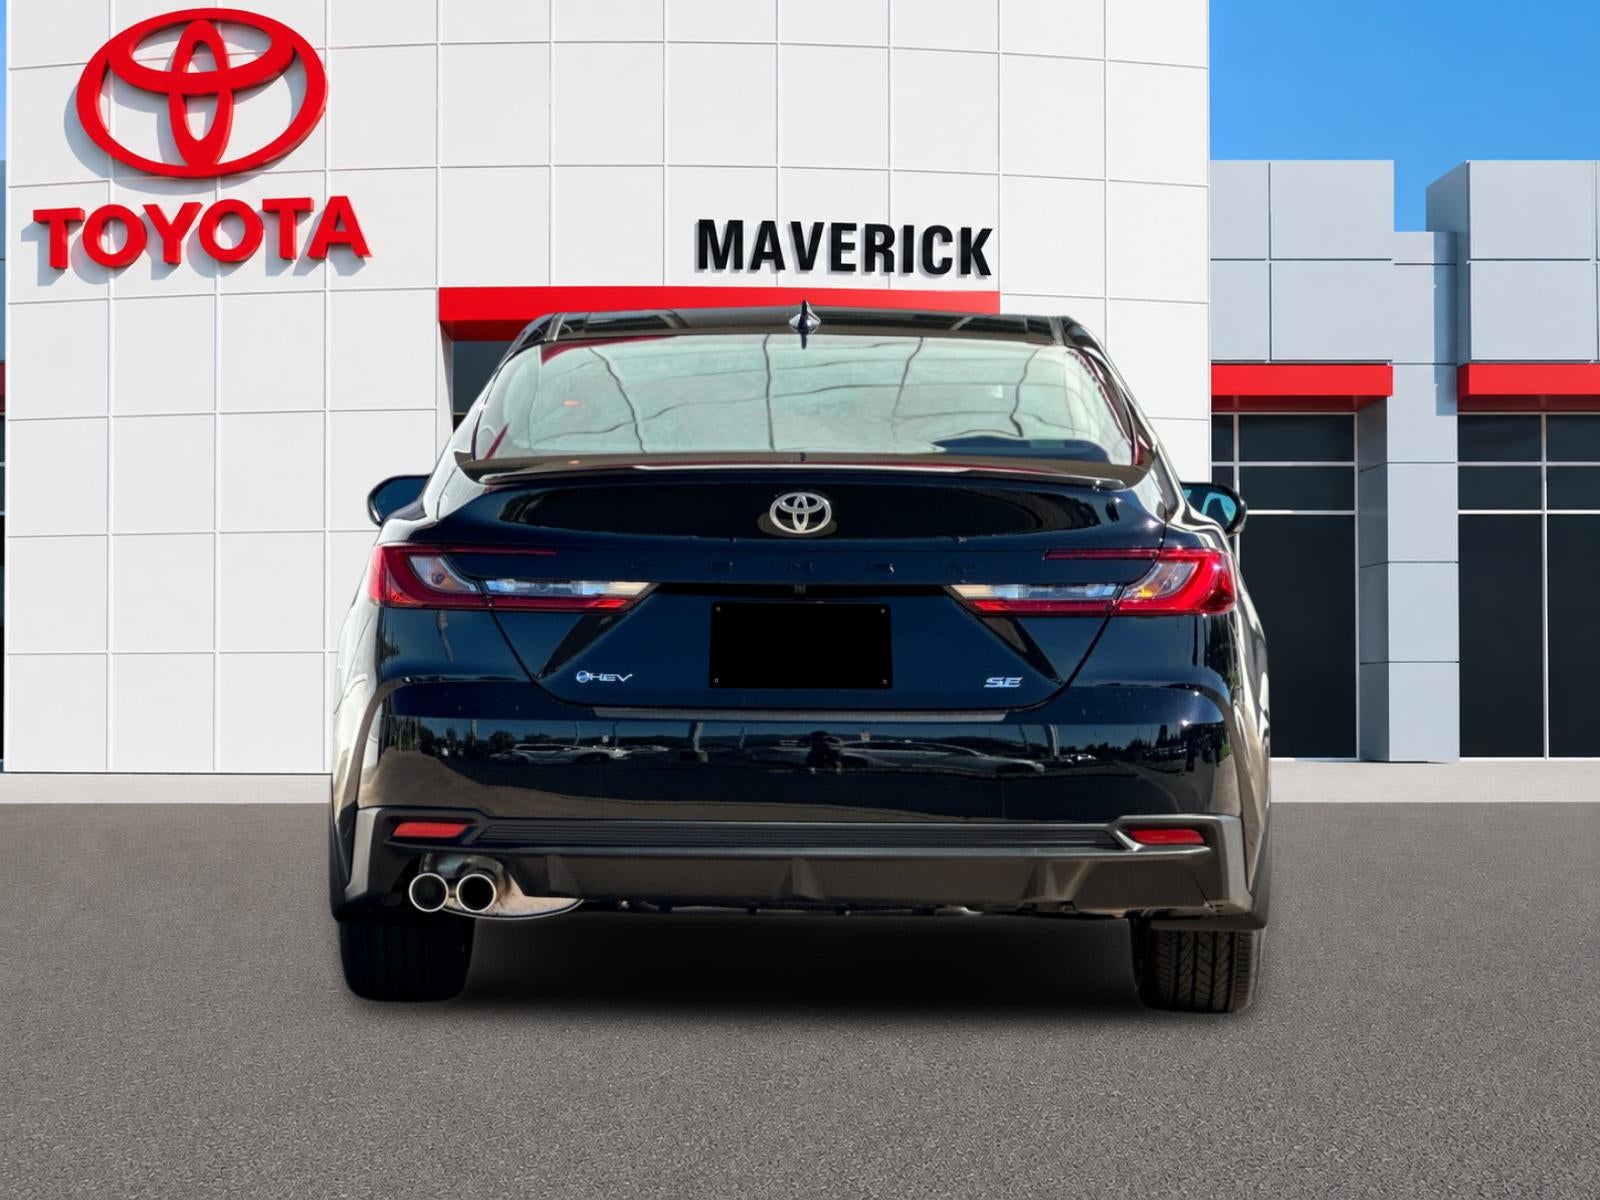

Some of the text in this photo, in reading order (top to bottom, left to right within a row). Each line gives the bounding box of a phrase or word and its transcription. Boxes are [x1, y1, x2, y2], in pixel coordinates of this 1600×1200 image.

[33, 195, 373, 271] TOYOTA
[697, 218, 993, 277] MAVERICK
[984, 676, 1023, 688] SE
